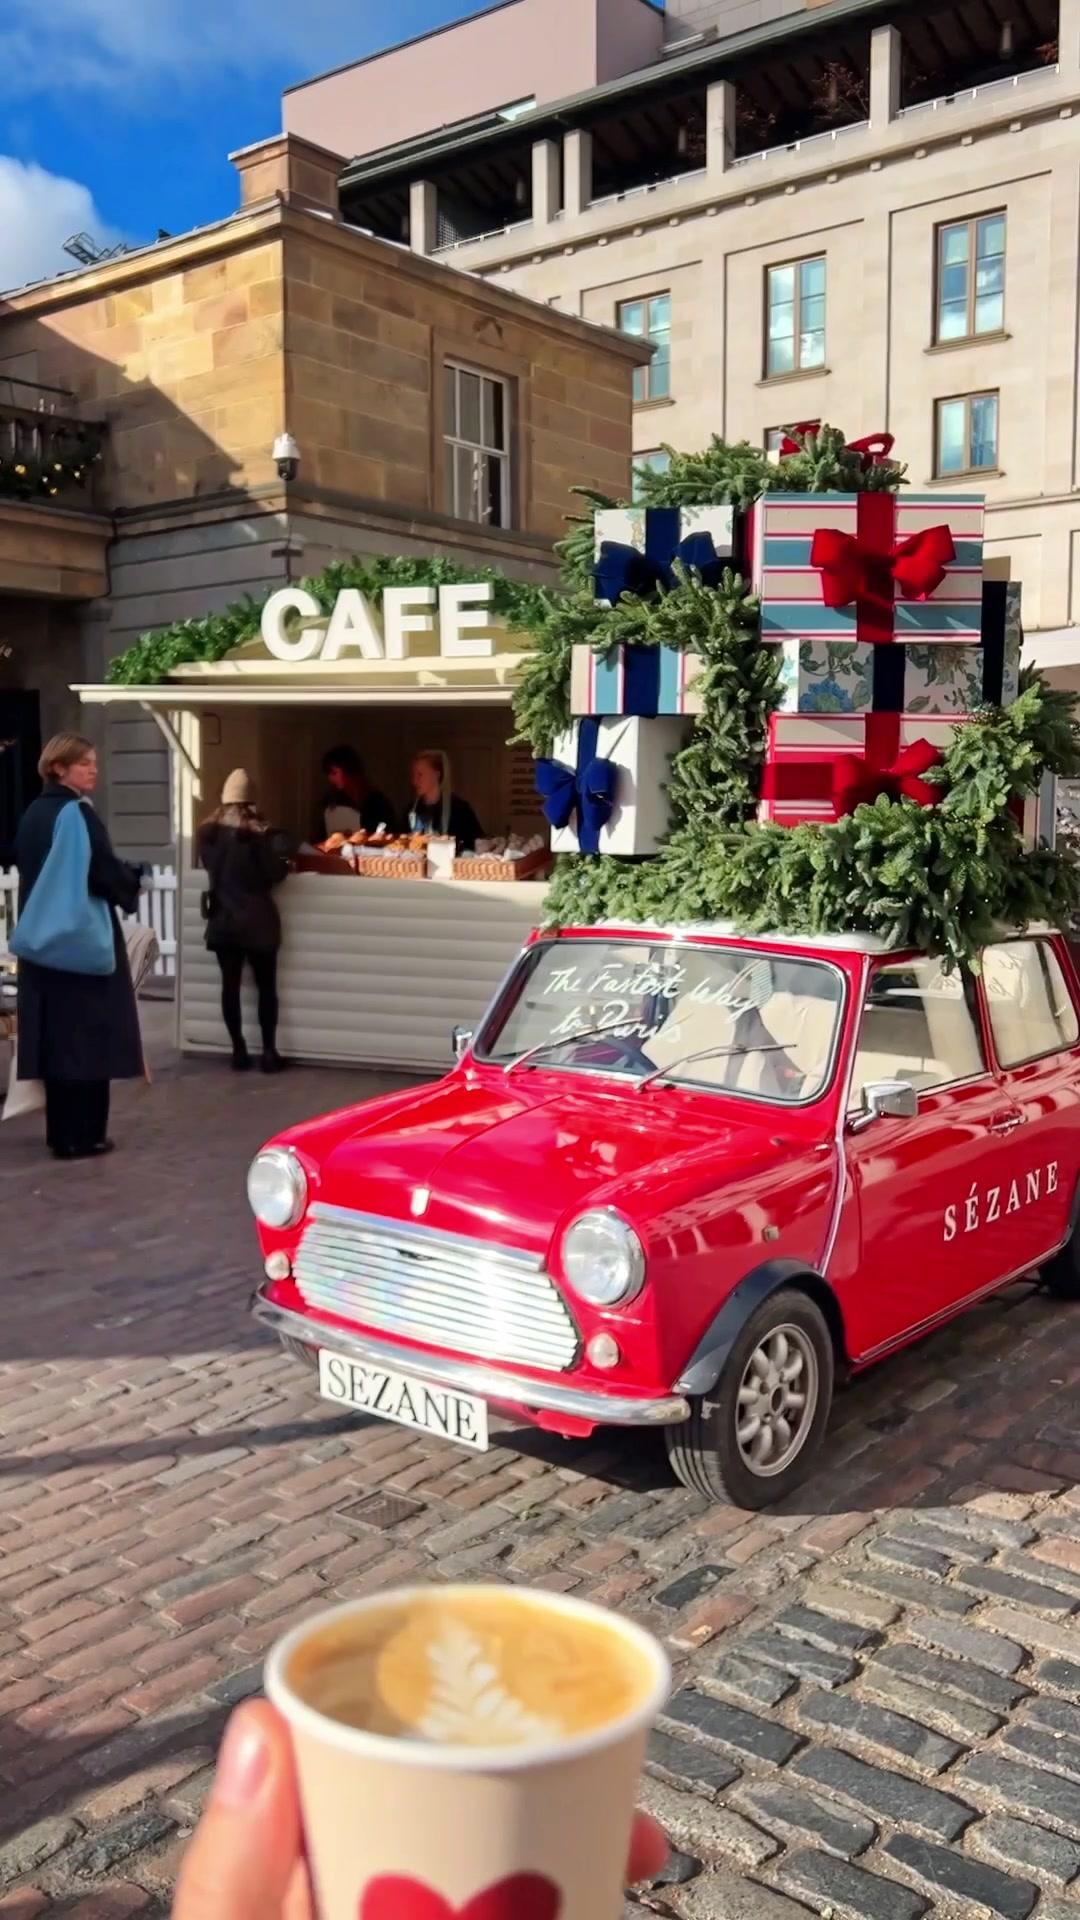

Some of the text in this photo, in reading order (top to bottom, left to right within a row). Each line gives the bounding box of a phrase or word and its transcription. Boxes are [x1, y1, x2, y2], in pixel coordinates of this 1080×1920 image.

[261, 583, 494, 662] CAFE
[543, 966, 582, 996] The
[688, 977, 764, 1024] Way
[549, 1006, 589, 1036] to
[943, 1160, 1058, 1242] SÉZANE
[327, 1358, 478, 1443] SEZANE
